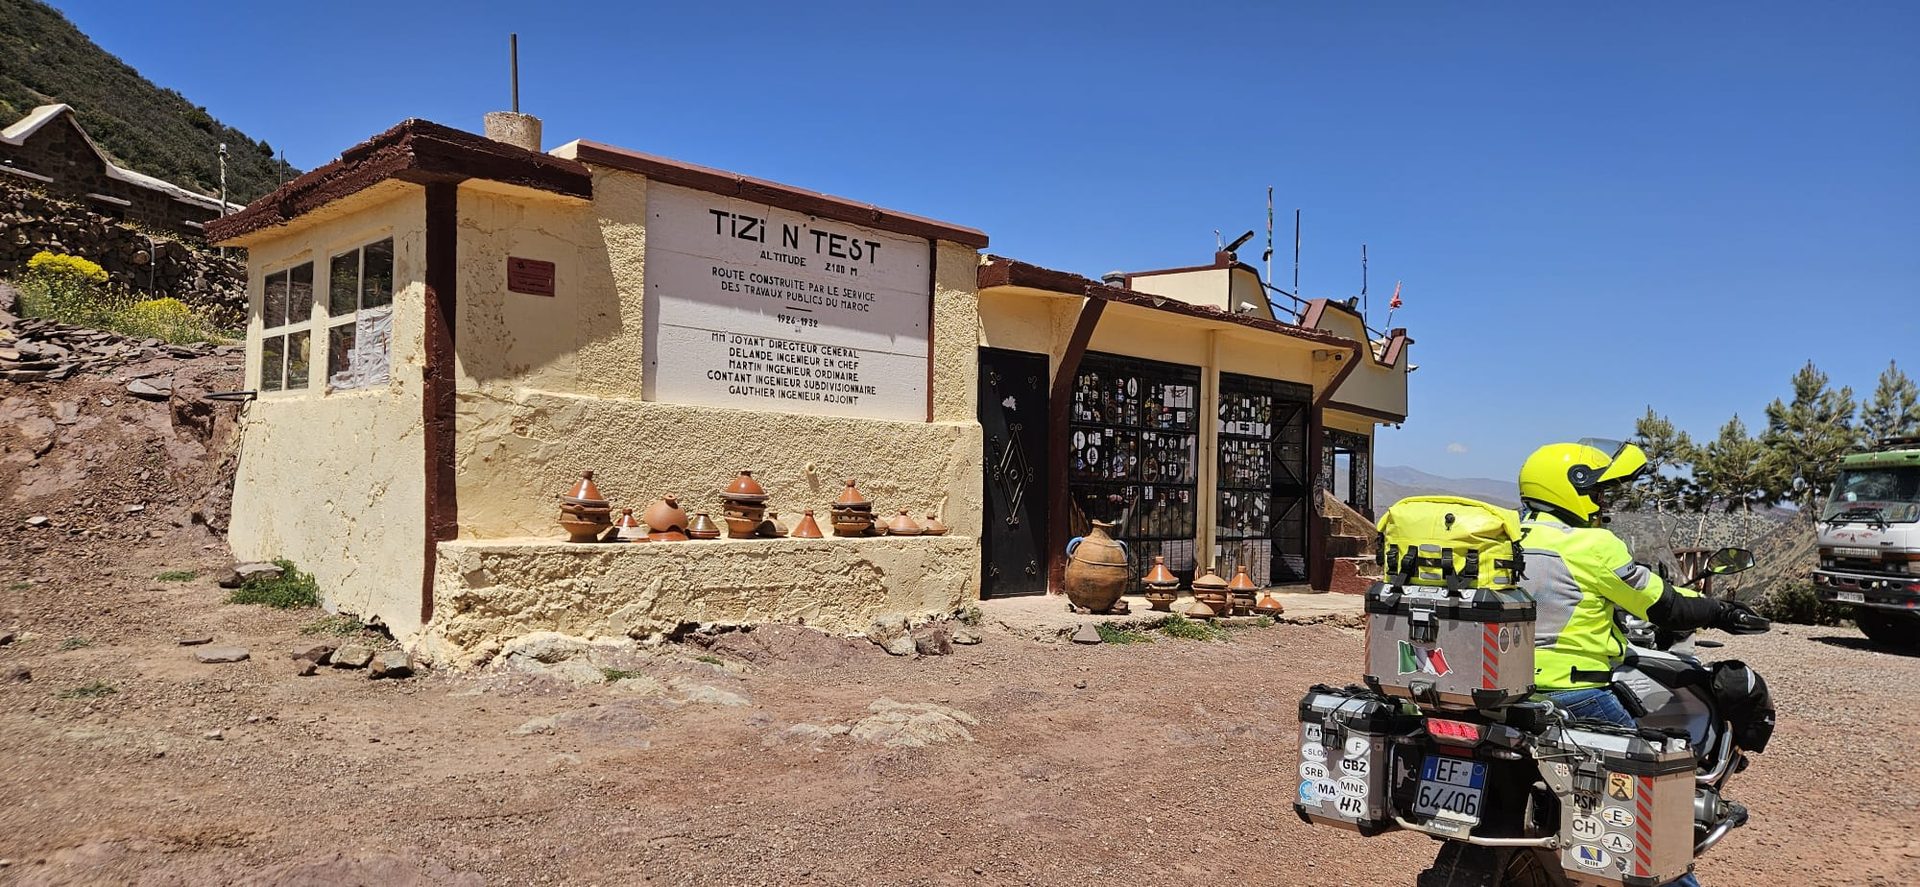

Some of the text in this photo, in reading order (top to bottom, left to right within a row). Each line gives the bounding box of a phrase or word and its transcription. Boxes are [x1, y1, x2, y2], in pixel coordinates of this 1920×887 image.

[760, 250, 807, 267] ALTITUDE
[850, 267, 858, 276] M
[712, 266, 876, 302] ROUTE CONSTRUITE PAR LE SERVICE
[721, 280, 870, 312] DES TRAVAUX PUBLICS DU MAROC
[711, 332, 726, 342] MM
[729, 335, 765, 347] JOYANT
[820, 346, 860, 359] GENERAL
[729, 347, 860, 371] DELANDE INGENIEUR EN CHEF
[728, 359, 859, 382] MARTIN INGENIEUR ORDINAIRE
[706, 370, 877, 396] CONTANT INGENIEUR SUBDIVISIONNAIRE
[728, 385, 859, 406] GAUTHIER INGENIEUR ADJOINT
[1354, 741, 1362, 752] F
[1304, 766, 1324, 778] SRB
[1342, 760, 1367, 773] GBZ
[1435, 759, 1462, 782] EF
[1340, 781, 1365, 794] MNE
[1339, 796, 1362, 814] HR
[1419, 785, 1478, 816] 64406
[1573, 793, 1597, 811] RSM
[1572, 818, 1596, 835] CH
[1613, 810, 1622, 822] E
[1612, 836, 1622, 848] A
